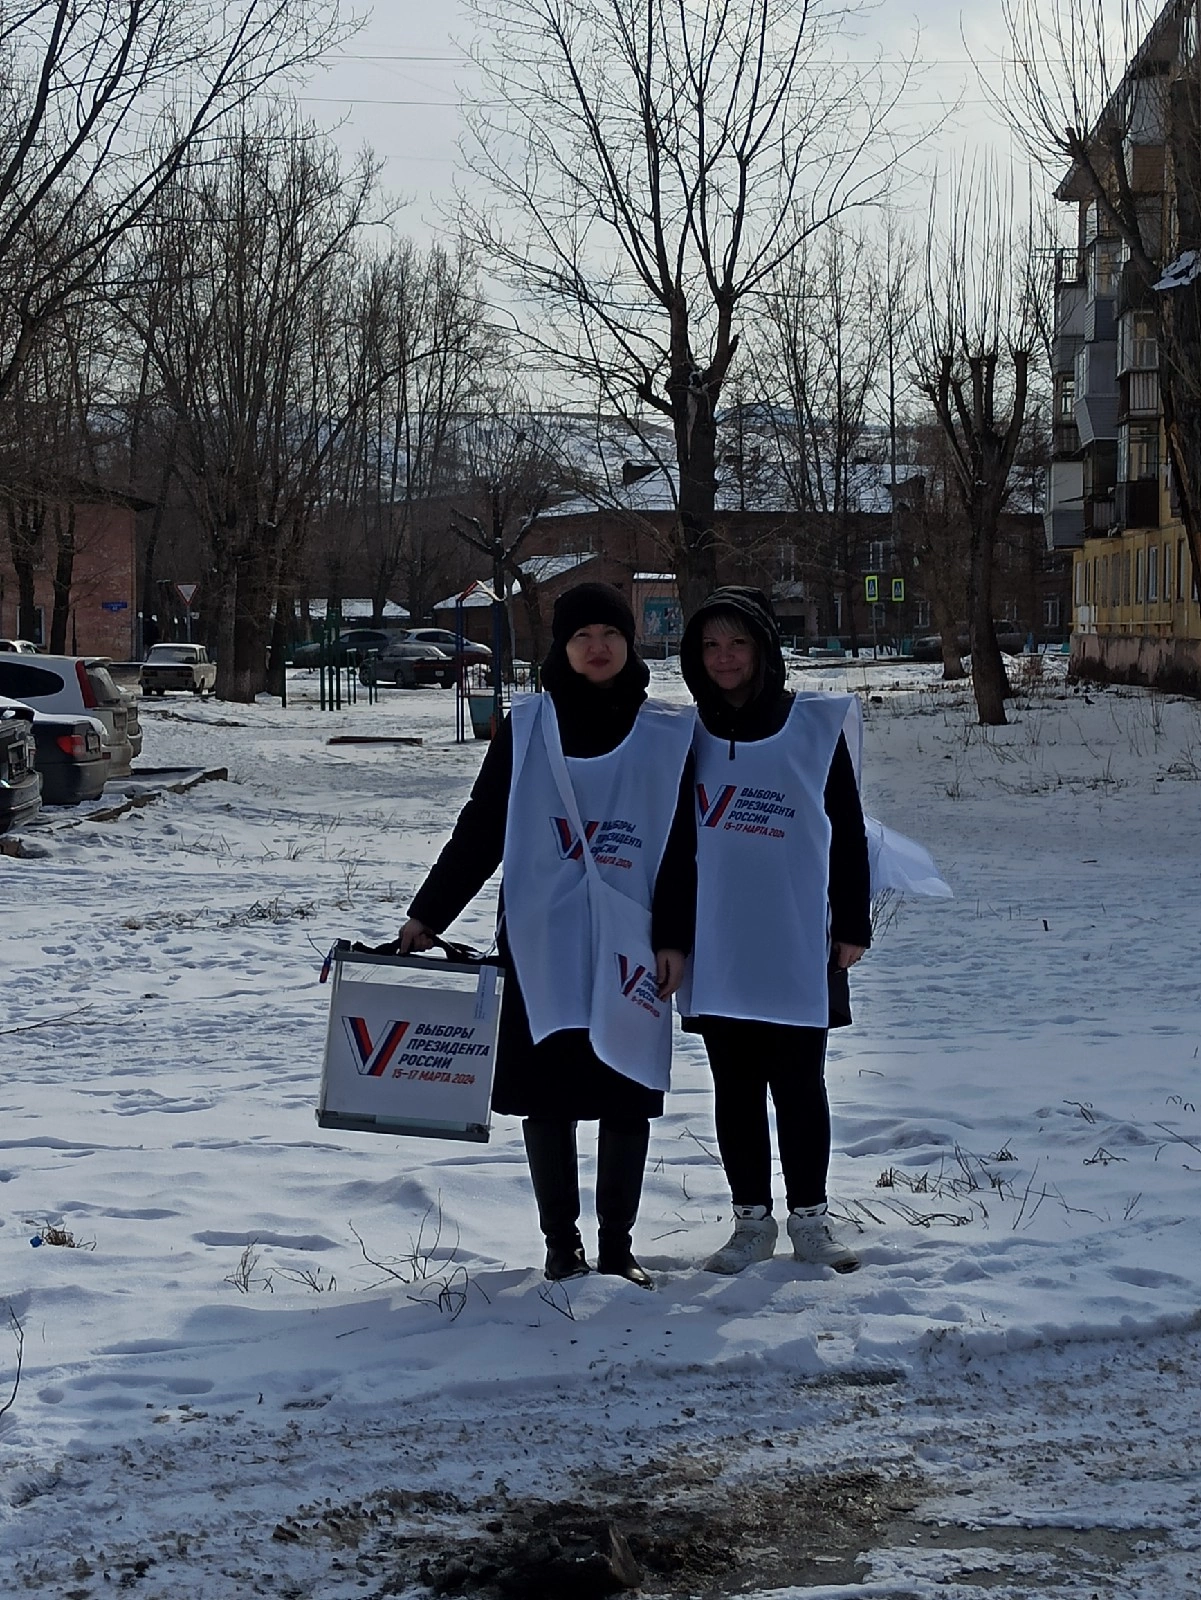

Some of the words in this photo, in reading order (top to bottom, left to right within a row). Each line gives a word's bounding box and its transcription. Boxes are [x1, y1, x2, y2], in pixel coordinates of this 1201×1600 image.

[740, 787, 785, 802] ВЫБОРЫ
[734, 799, 796, 818] ПРЕЗИДЕНТА
[728, 811, 770, 824] РОССИИ
[742, 824, 768, 836] МАРТА
[414, 1023, 475, 1039] ВЫБОРЫ
[406, 1038, 491, 1057] ПРЕЗИДЕНТА
[398, 1053, 453, 1069] РОССИИ
[418, 1070, 451, 1083] МАРТА
[451, 1073, 476, 1085] 2024
